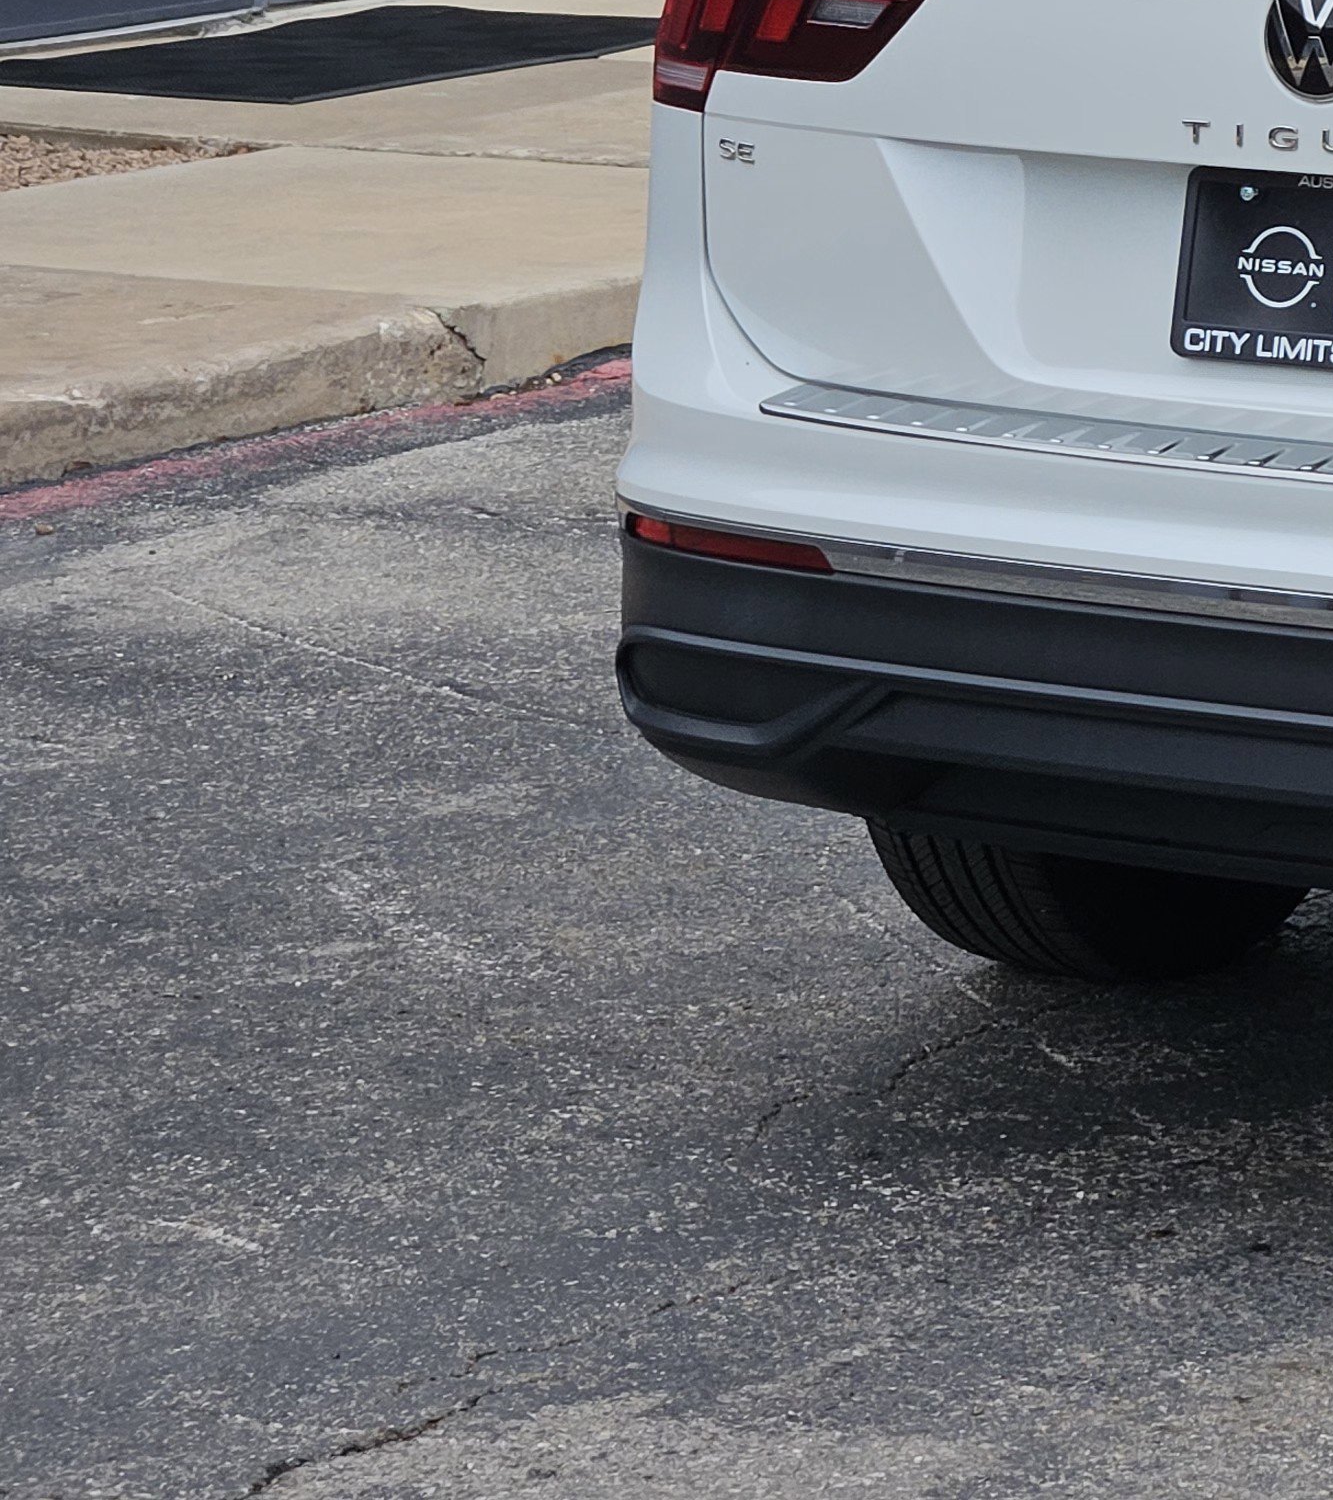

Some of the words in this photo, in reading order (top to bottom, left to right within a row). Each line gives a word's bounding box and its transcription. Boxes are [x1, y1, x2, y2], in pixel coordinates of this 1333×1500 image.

[718, 137, 756, 165] SE
[1237, 256, 1325, 279] NISSAN
[1184, 328, 1251, 354] CITY
